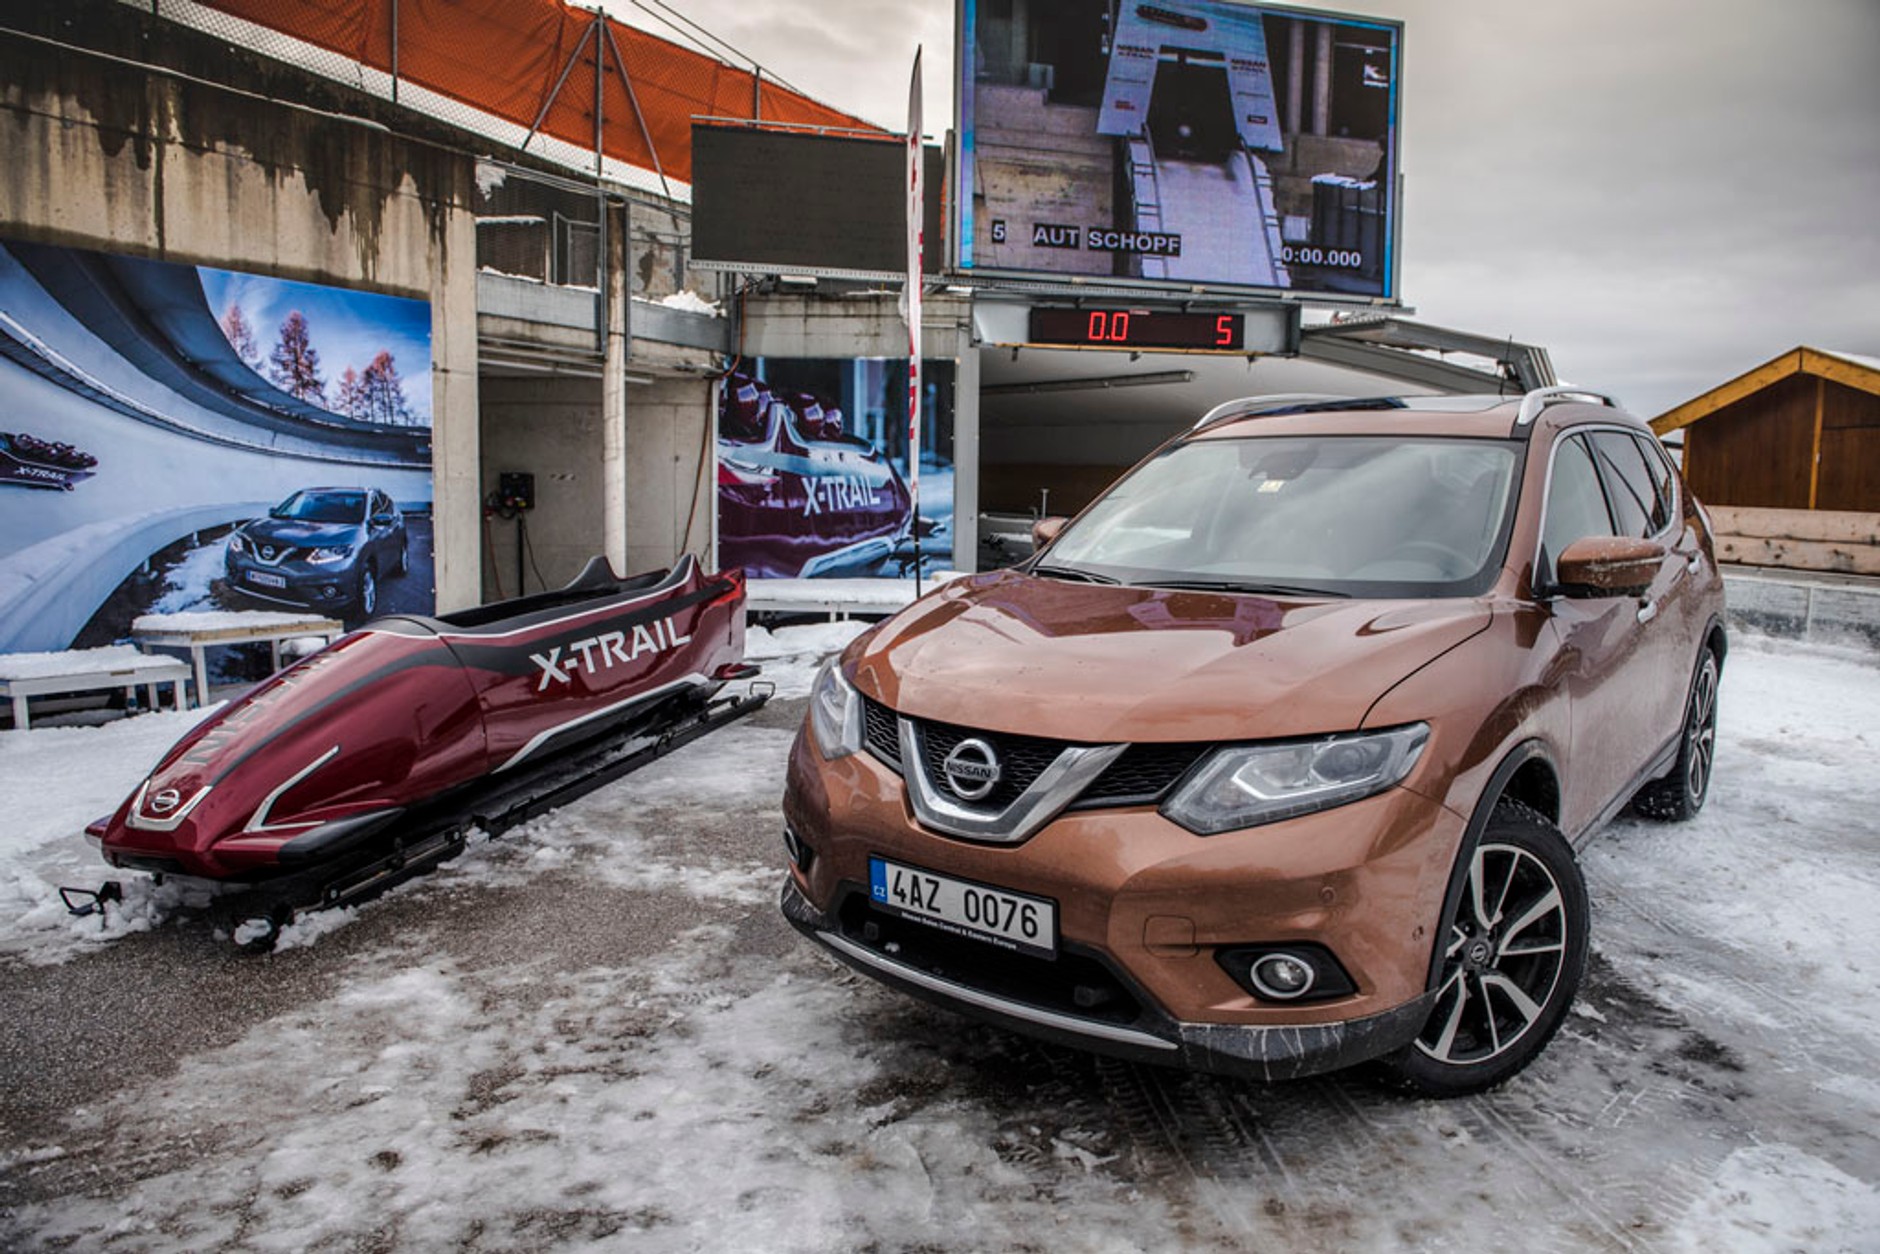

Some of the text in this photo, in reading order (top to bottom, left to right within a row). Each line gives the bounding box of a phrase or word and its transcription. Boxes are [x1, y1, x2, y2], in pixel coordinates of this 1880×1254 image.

[992, 223, 1181, 253] 5 AUT SCHÖPF
[1282, 247, 1362, 268] 0:00.000
[1088, 311, 1233, 345] 0.0 5
[801, 475, 881, 517] X-TRAIL
[529, 616, 692, 692] X-TRAIL
[946, 761, 992, 779] NISSAN
[873, 885, 886, 898] CZ
[892, 870, 1038, 938] 4AZ 0076
